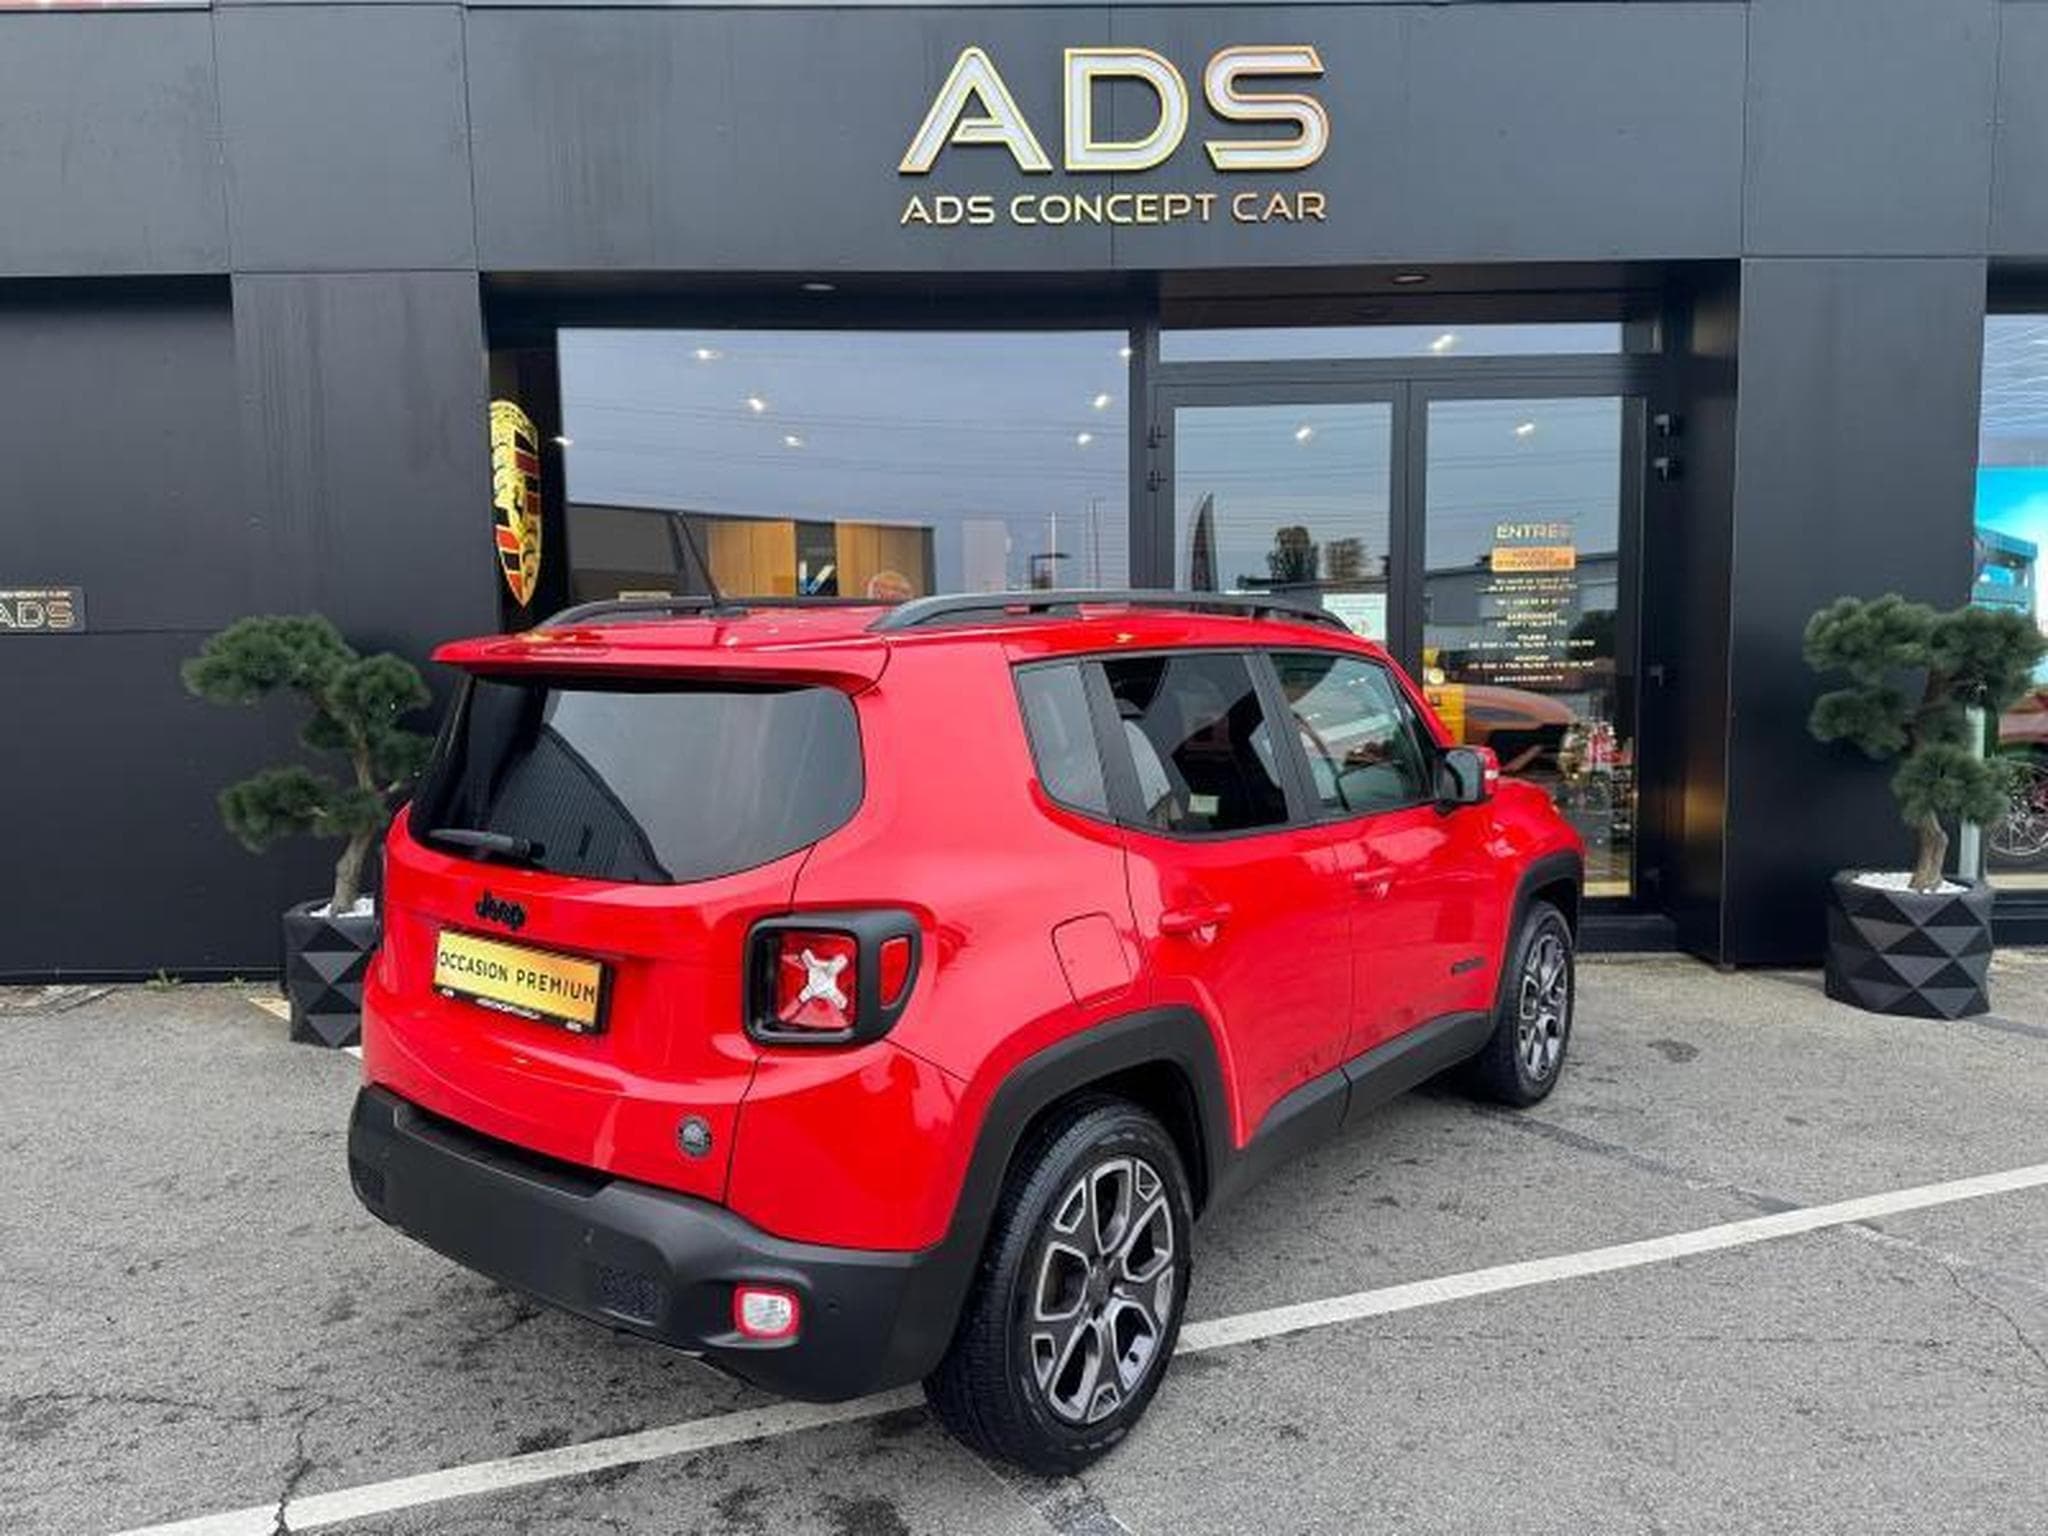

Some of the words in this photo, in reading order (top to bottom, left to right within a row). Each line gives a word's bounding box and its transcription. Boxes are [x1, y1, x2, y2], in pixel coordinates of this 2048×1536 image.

[899, 46, 1329, 173] ADS
[901, 195, 995, 225] ADS
[1010, 193, 1217, 225] CONCEPT
[1233, 191, 1328, 223] CAR
[439, 951, 508, 984] OCCASION
[516, 968, 595, 1004] PREMIUM
